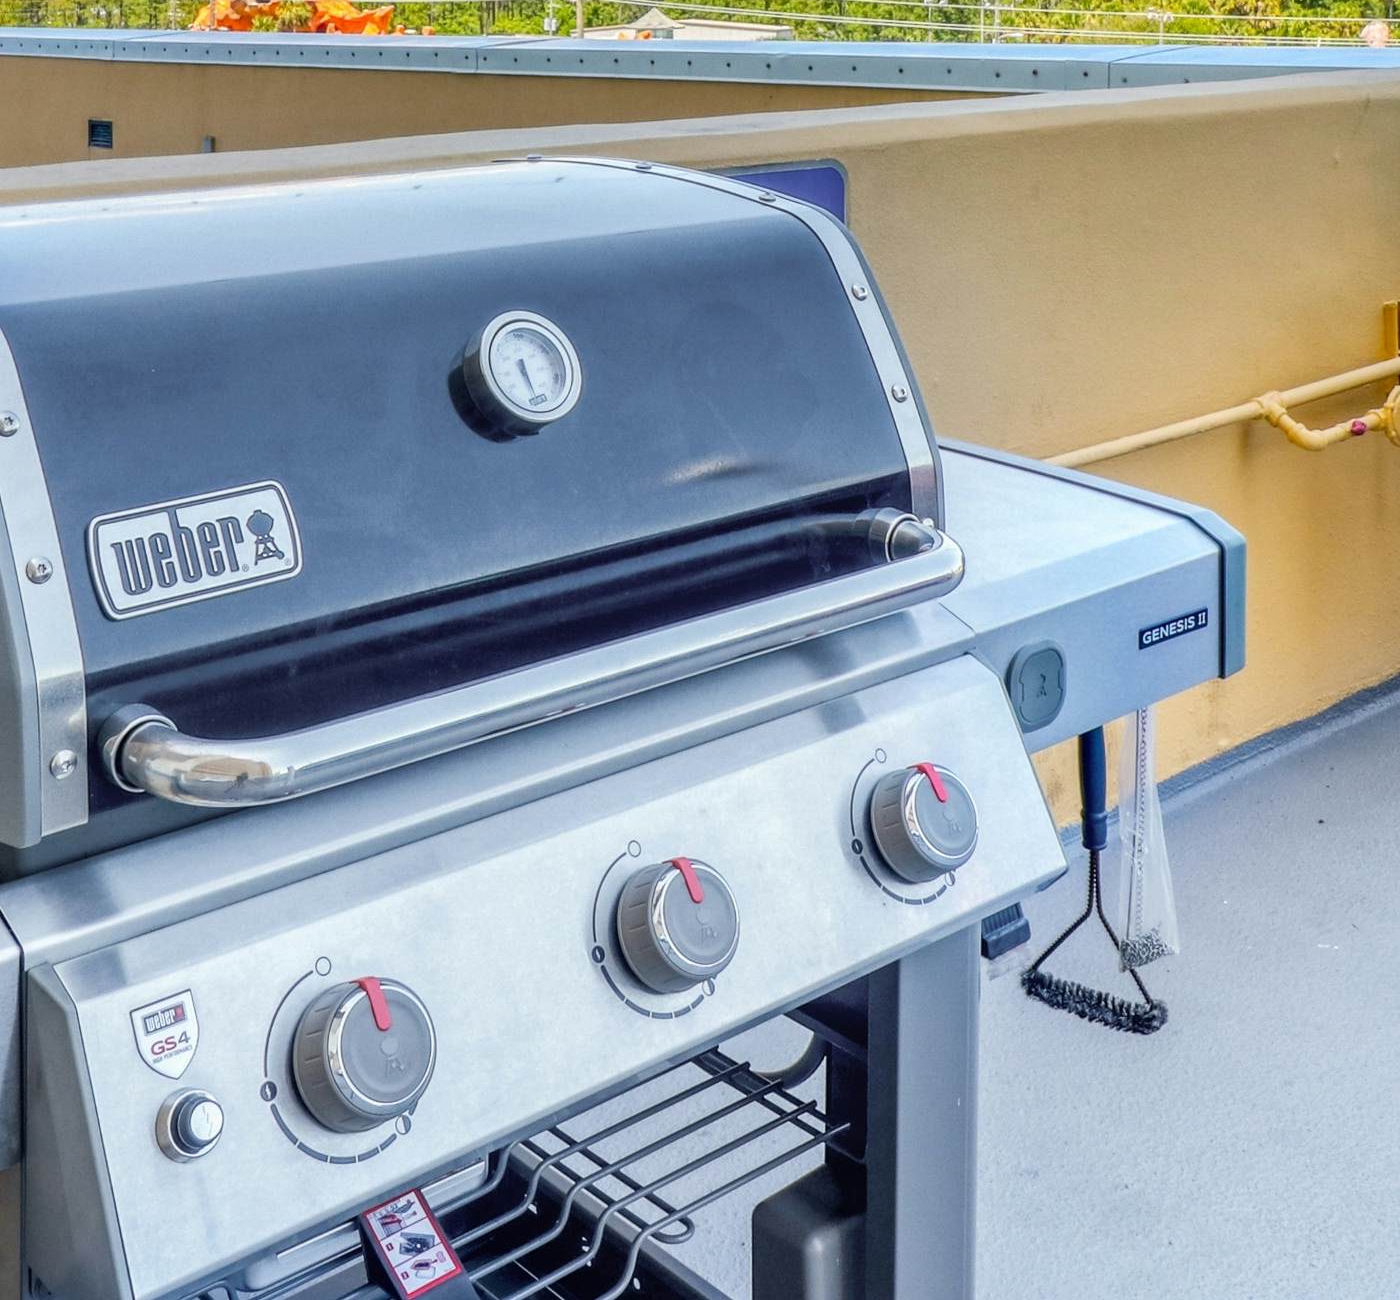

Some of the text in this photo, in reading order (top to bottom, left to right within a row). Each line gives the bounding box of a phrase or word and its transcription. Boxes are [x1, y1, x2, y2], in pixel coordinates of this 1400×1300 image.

[1142, 612, 1206, 645] GENESIS II
[145, 1008, 175, 1032] weber
[150, 1030, 191, 1056] GS4
